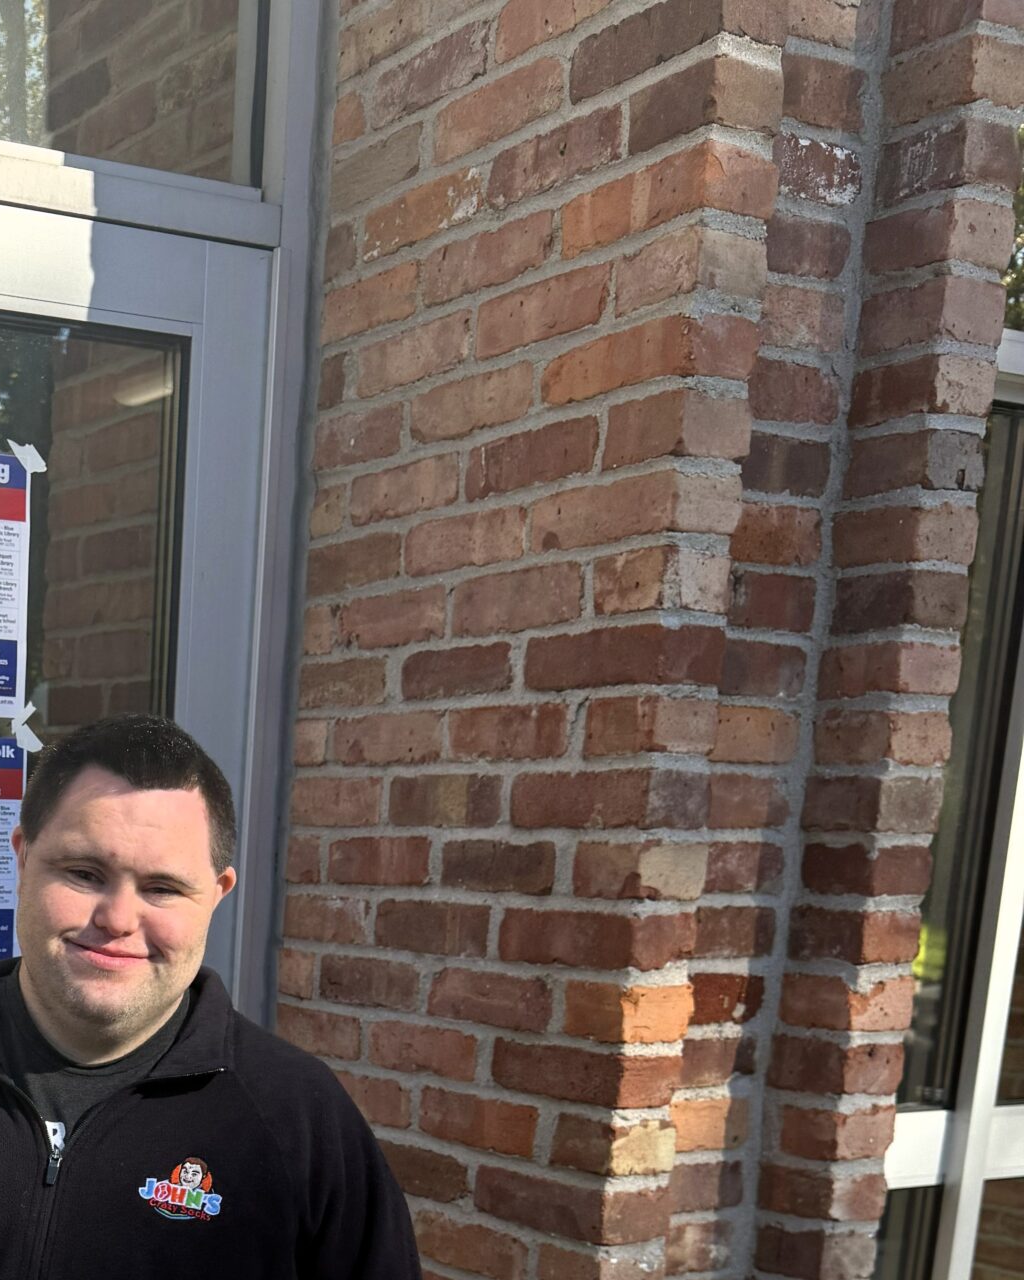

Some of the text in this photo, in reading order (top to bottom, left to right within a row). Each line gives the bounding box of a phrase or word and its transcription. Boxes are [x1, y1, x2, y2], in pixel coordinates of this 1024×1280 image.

[139, 1178, 222, 1215] JOHN'S
[149, 1198, 211, 1221] Crazy Socks
